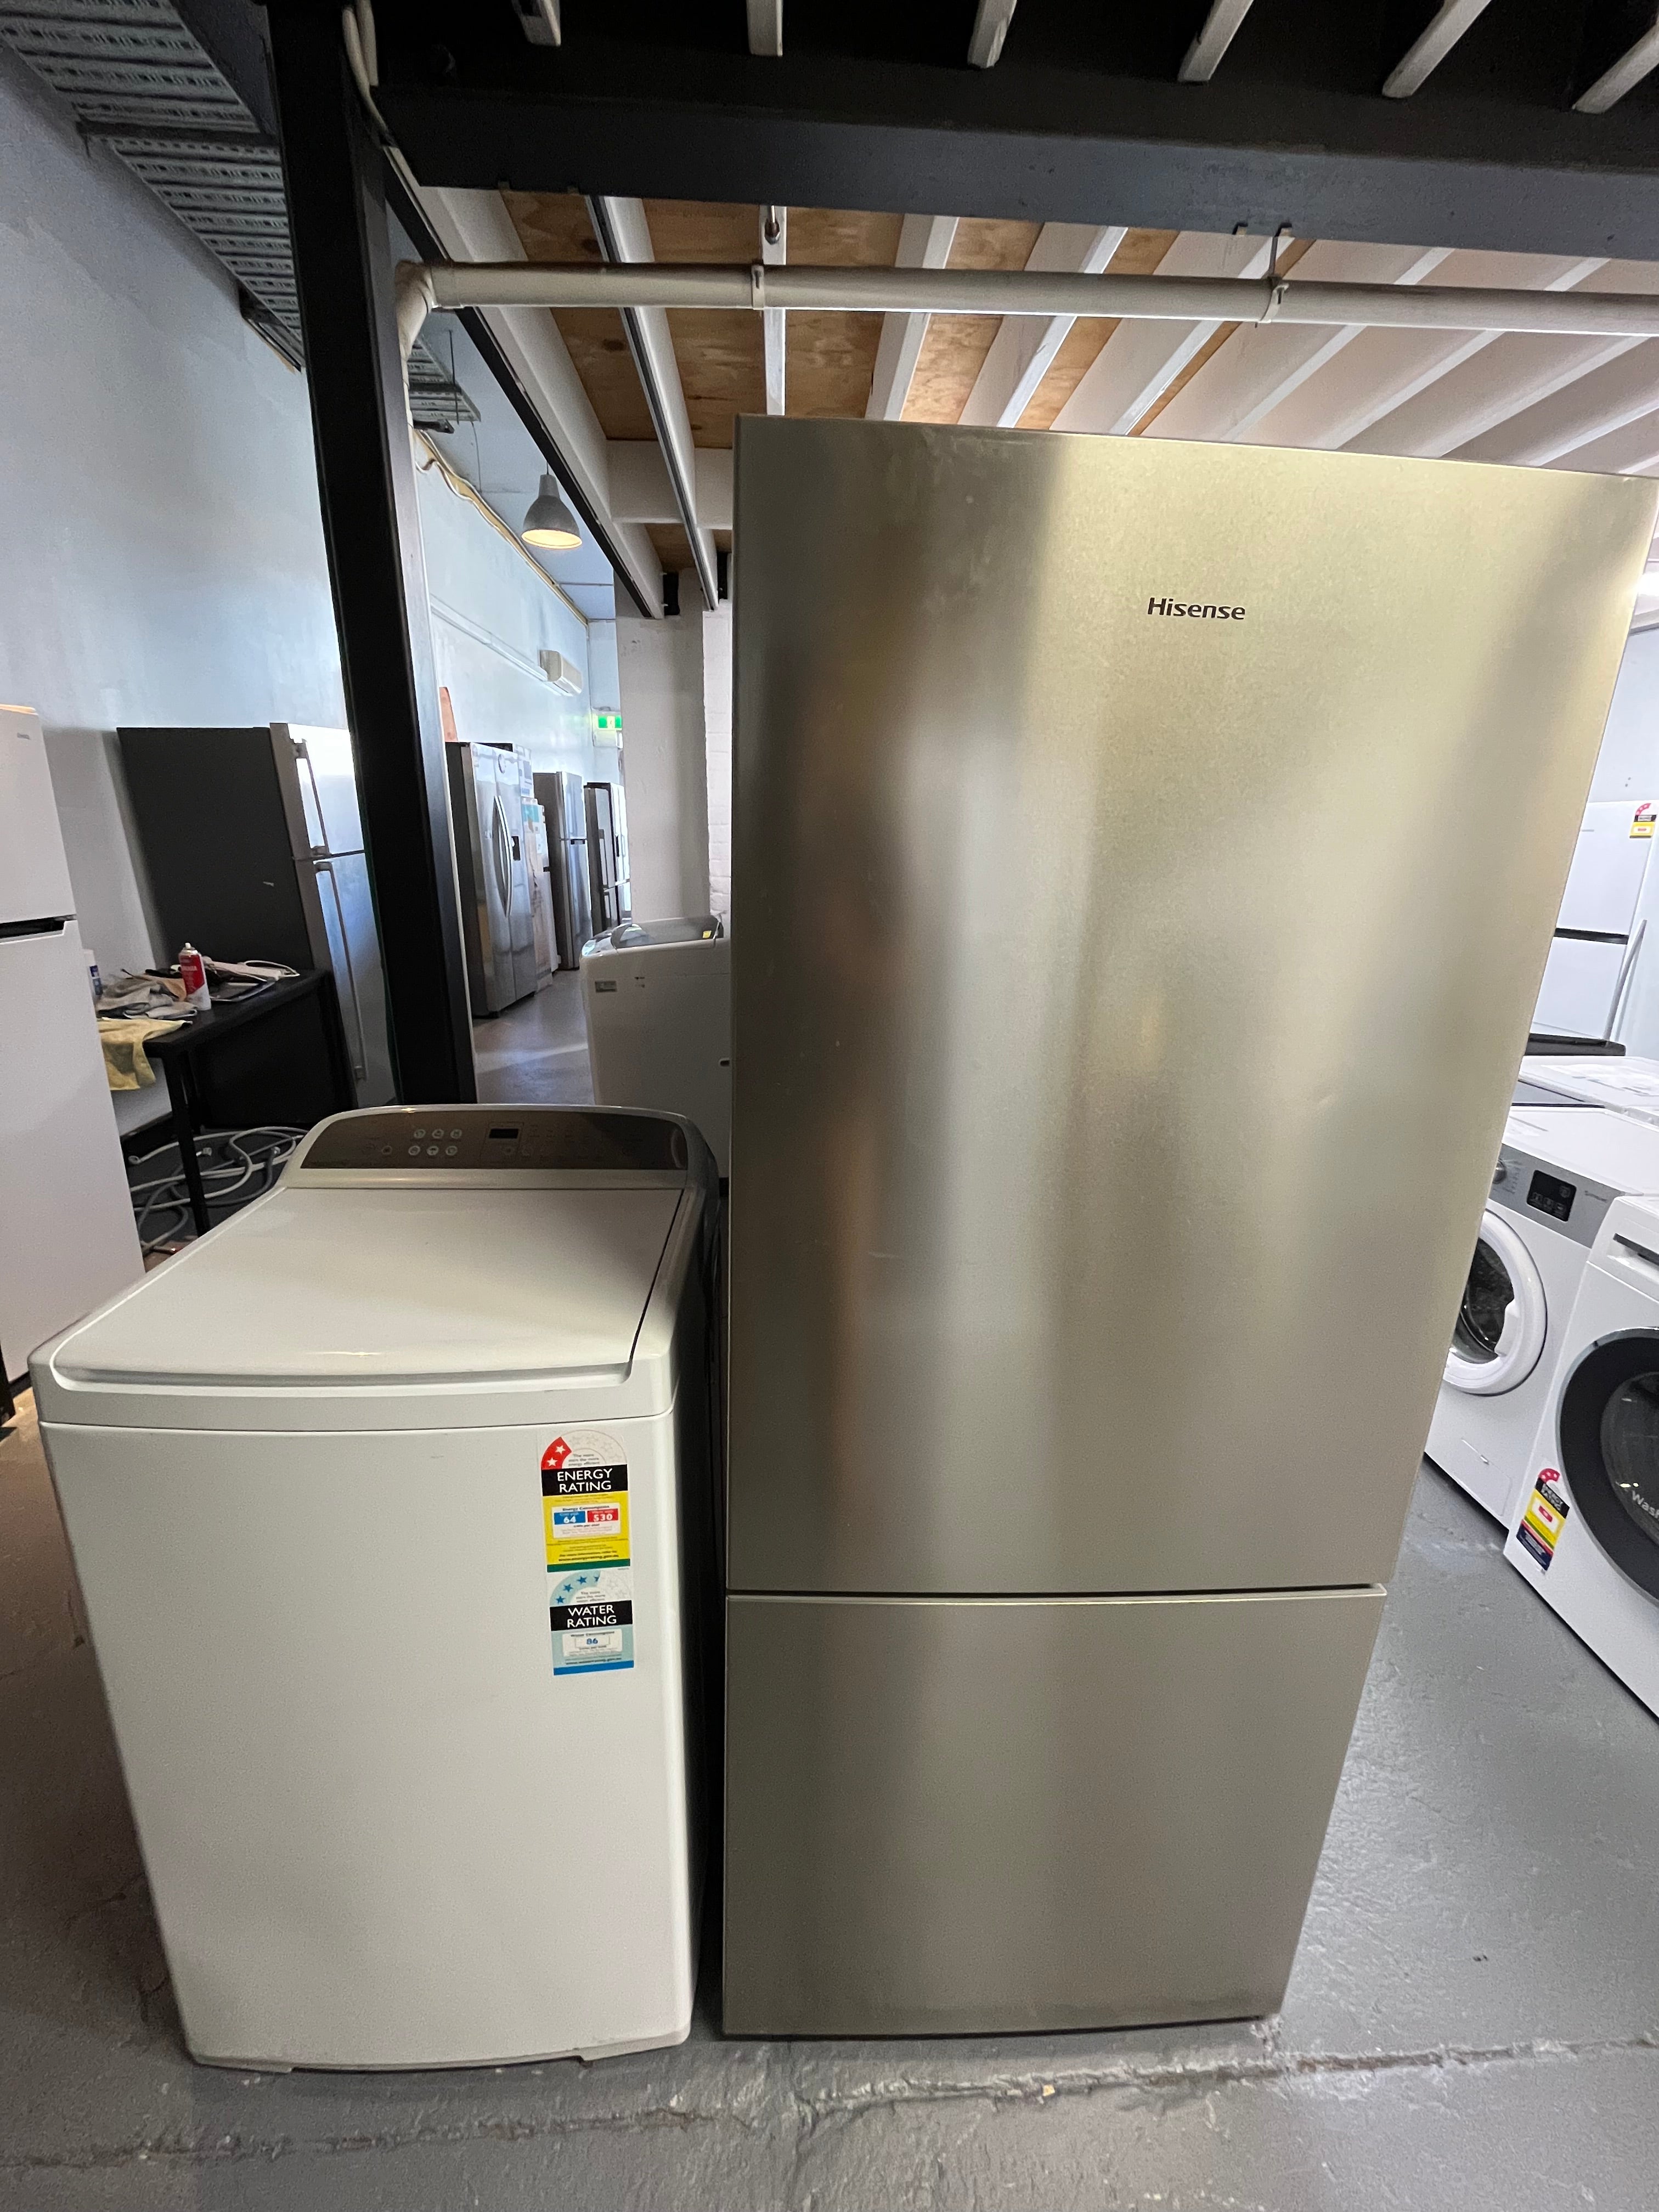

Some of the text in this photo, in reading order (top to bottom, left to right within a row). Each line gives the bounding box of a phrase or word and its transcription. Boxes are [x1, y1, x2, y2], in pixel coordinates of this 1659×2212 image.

[1147, 597, 1246, 620] Hisense
[557, 1468, 613, 1481] ENERGY
[559, 1480, 612, 1493] RATING
[563, 1515, 577, 1523] 64
[593, 1513, 613, 1522] 530
[567, 1604, 614, 1616] WATER
[567, 1615, 617, 1628] RATING
